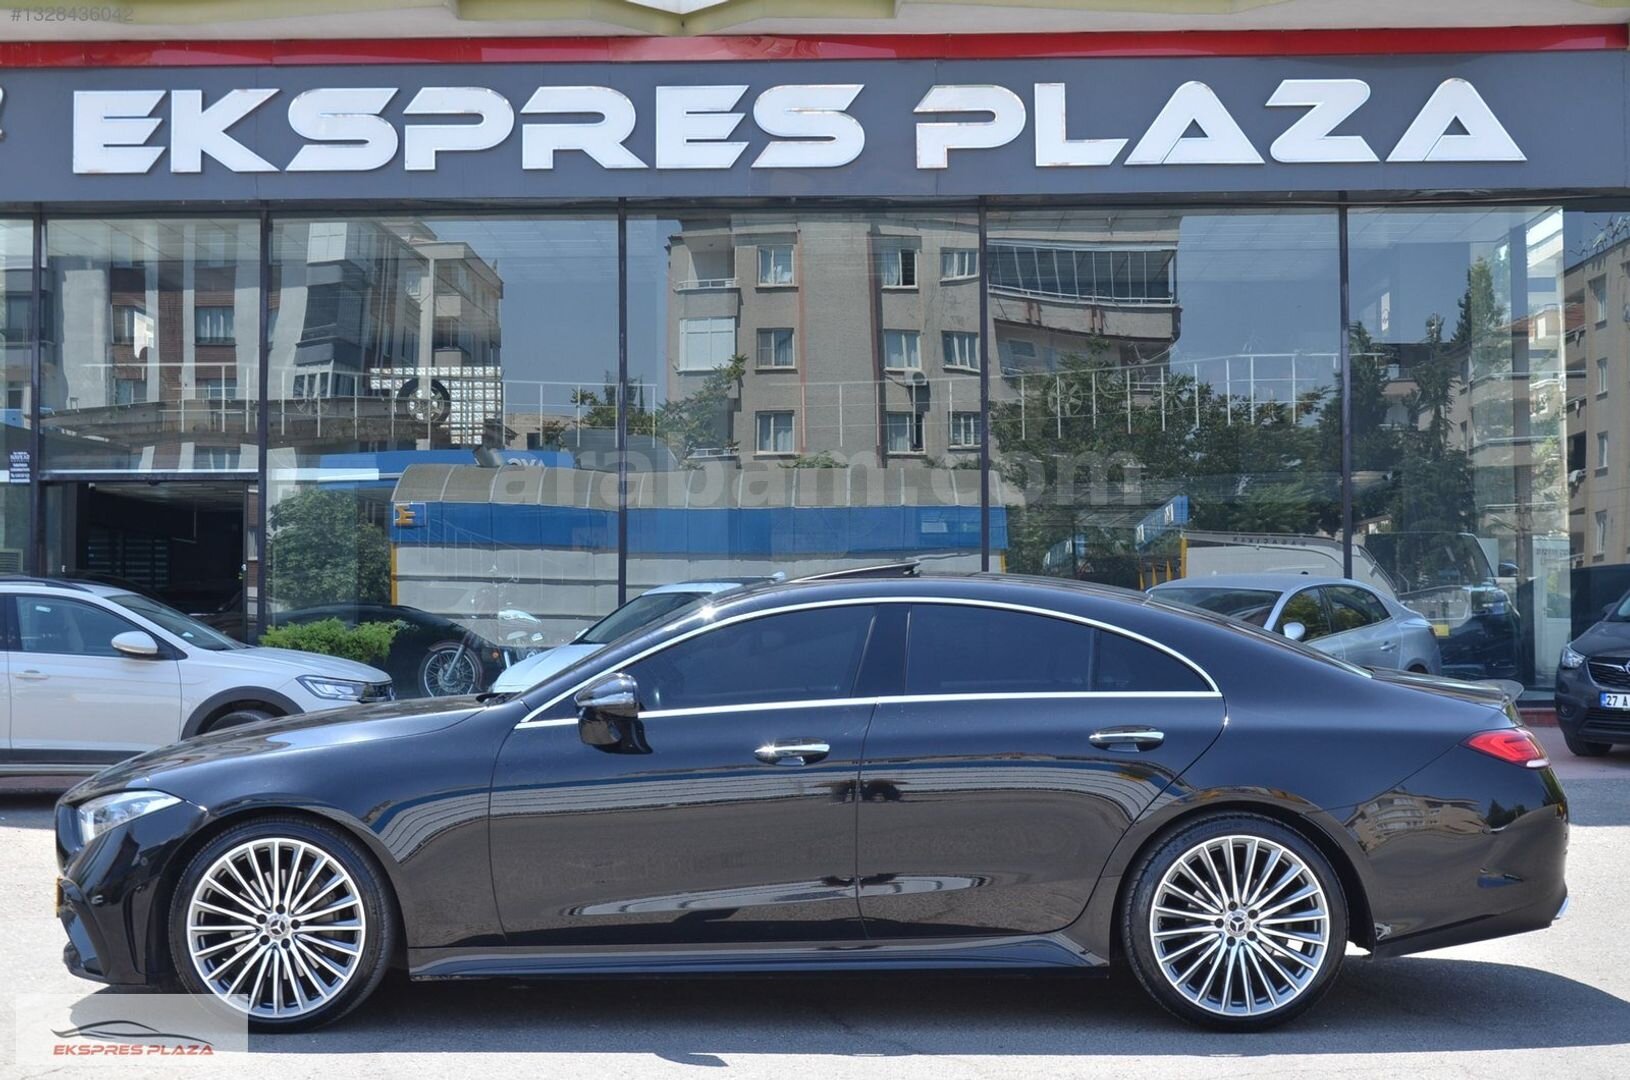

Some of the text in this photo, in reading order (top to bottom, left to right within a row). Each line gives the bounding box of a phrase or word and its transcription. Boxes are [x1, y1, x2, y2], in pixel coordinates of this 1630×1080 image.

[73, 79, 1528, 174] EKSPRES PLAZA
[1606, 695, 1618, 706] 27
